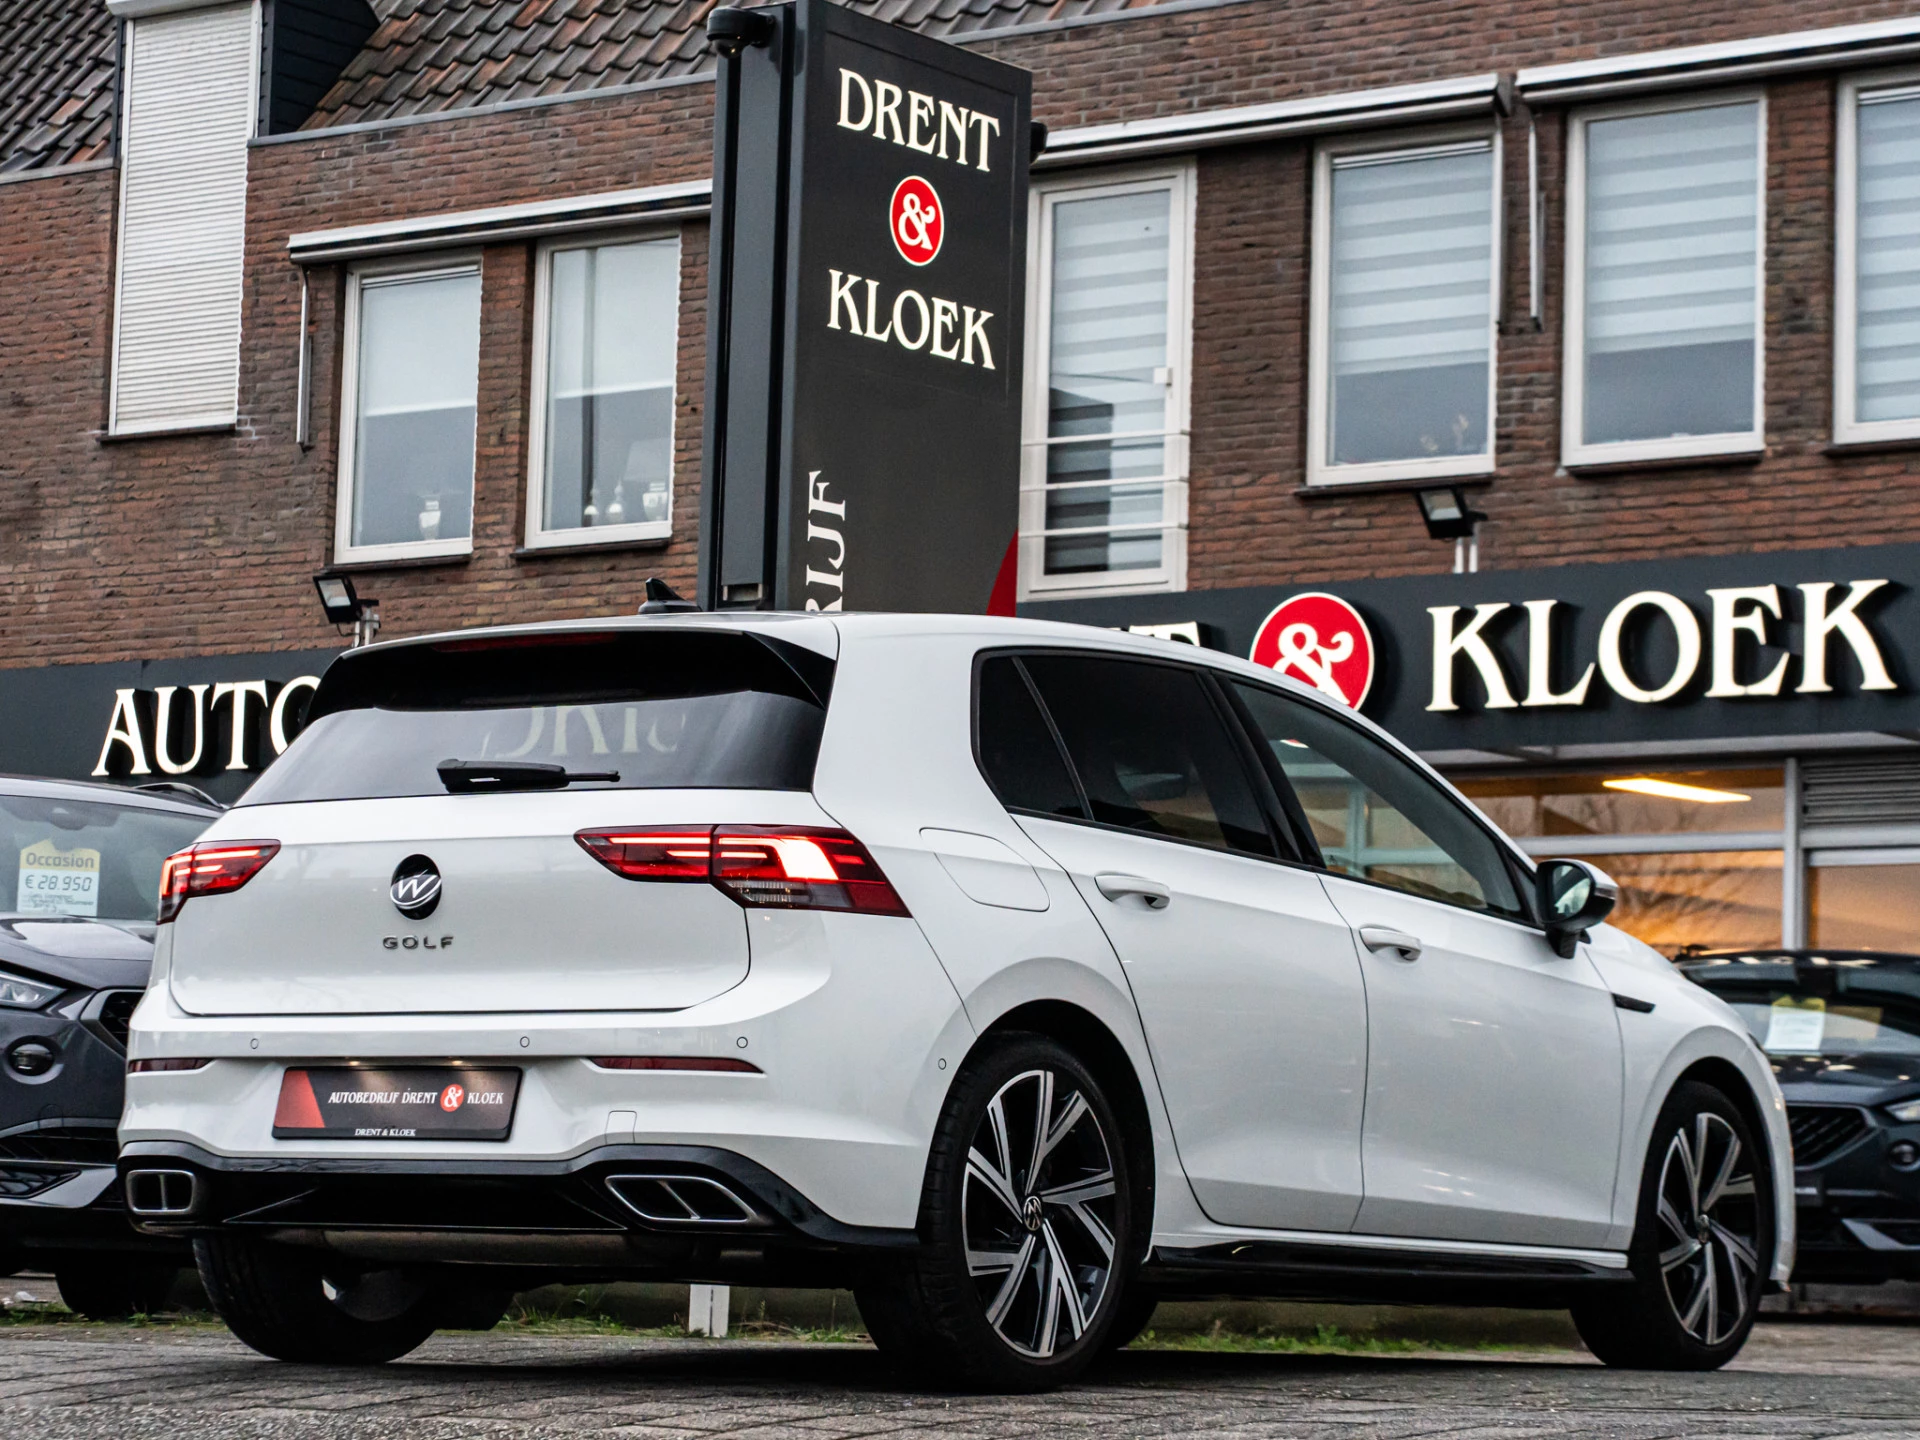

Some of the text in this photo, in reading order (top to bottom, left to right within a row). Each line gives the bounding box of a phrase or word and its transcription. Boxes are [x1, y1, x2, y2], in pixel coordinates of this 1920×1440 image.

[837, 67, 1000, 172] DRENT
[898, 193, 935, 250] &
[827, 268, 996, 370] KLOEK
[1272, 622, 1354, 705] &
[1425, 578, 1898, 711] KLOEK
[26, 852, 95, 869] Occasion
[382, 935, 454, 950] GOLF
[328, 1086, 504, 1108] AUTOBEDRIJF DRENT & KLOEK
[354, 1128, 381, 1137] DRENT
[390, 1128, 416, 1137] KLOEK
